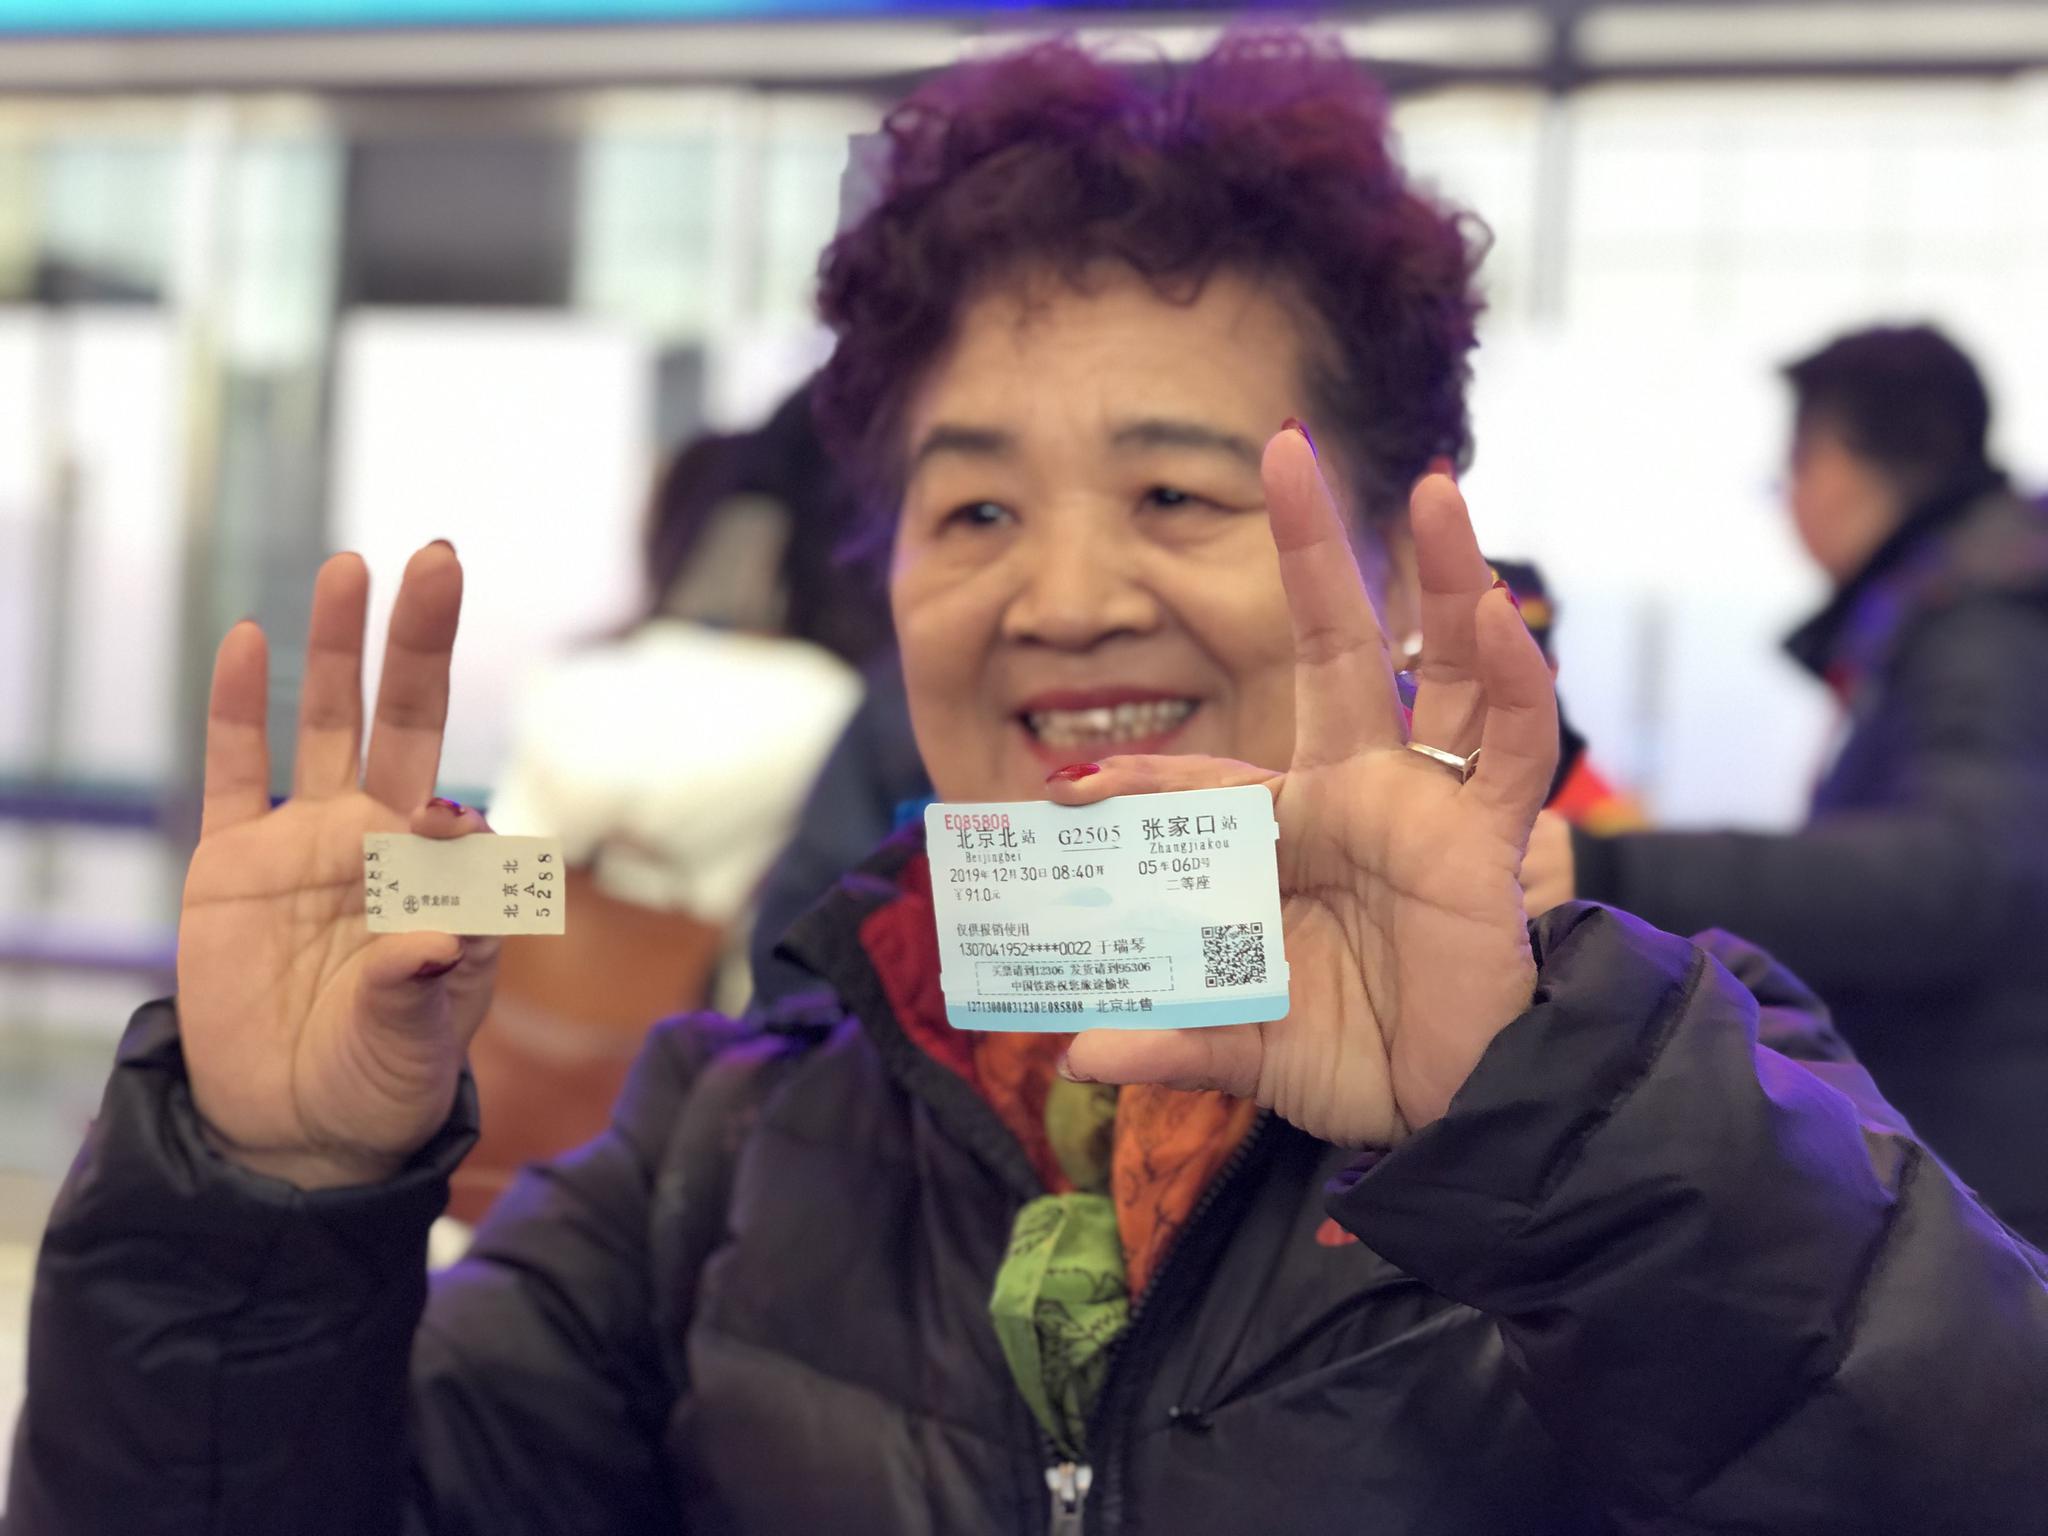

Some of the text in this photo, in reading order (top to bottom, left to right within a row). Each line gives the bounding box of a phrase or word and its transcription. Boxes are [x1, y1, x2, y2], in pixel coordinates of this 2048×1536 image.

[944, 814, 1011, 830] E085808
[1058, 825, 1121, 846] G2505
[965, 839, 1230, 864] Beijingbei Zhangjiakou
[524, 882, 536, 896] A
[536, 853, 554, 917] 5288
[1166, 875, 1211, 891] 二等座
[957, 923, 1030, 937] 仅供报销使用
[1011, 977, 1130, 992] 中国铁路祝您旅途愉快
[1096, 997, 1154, 1014] 北京北售
